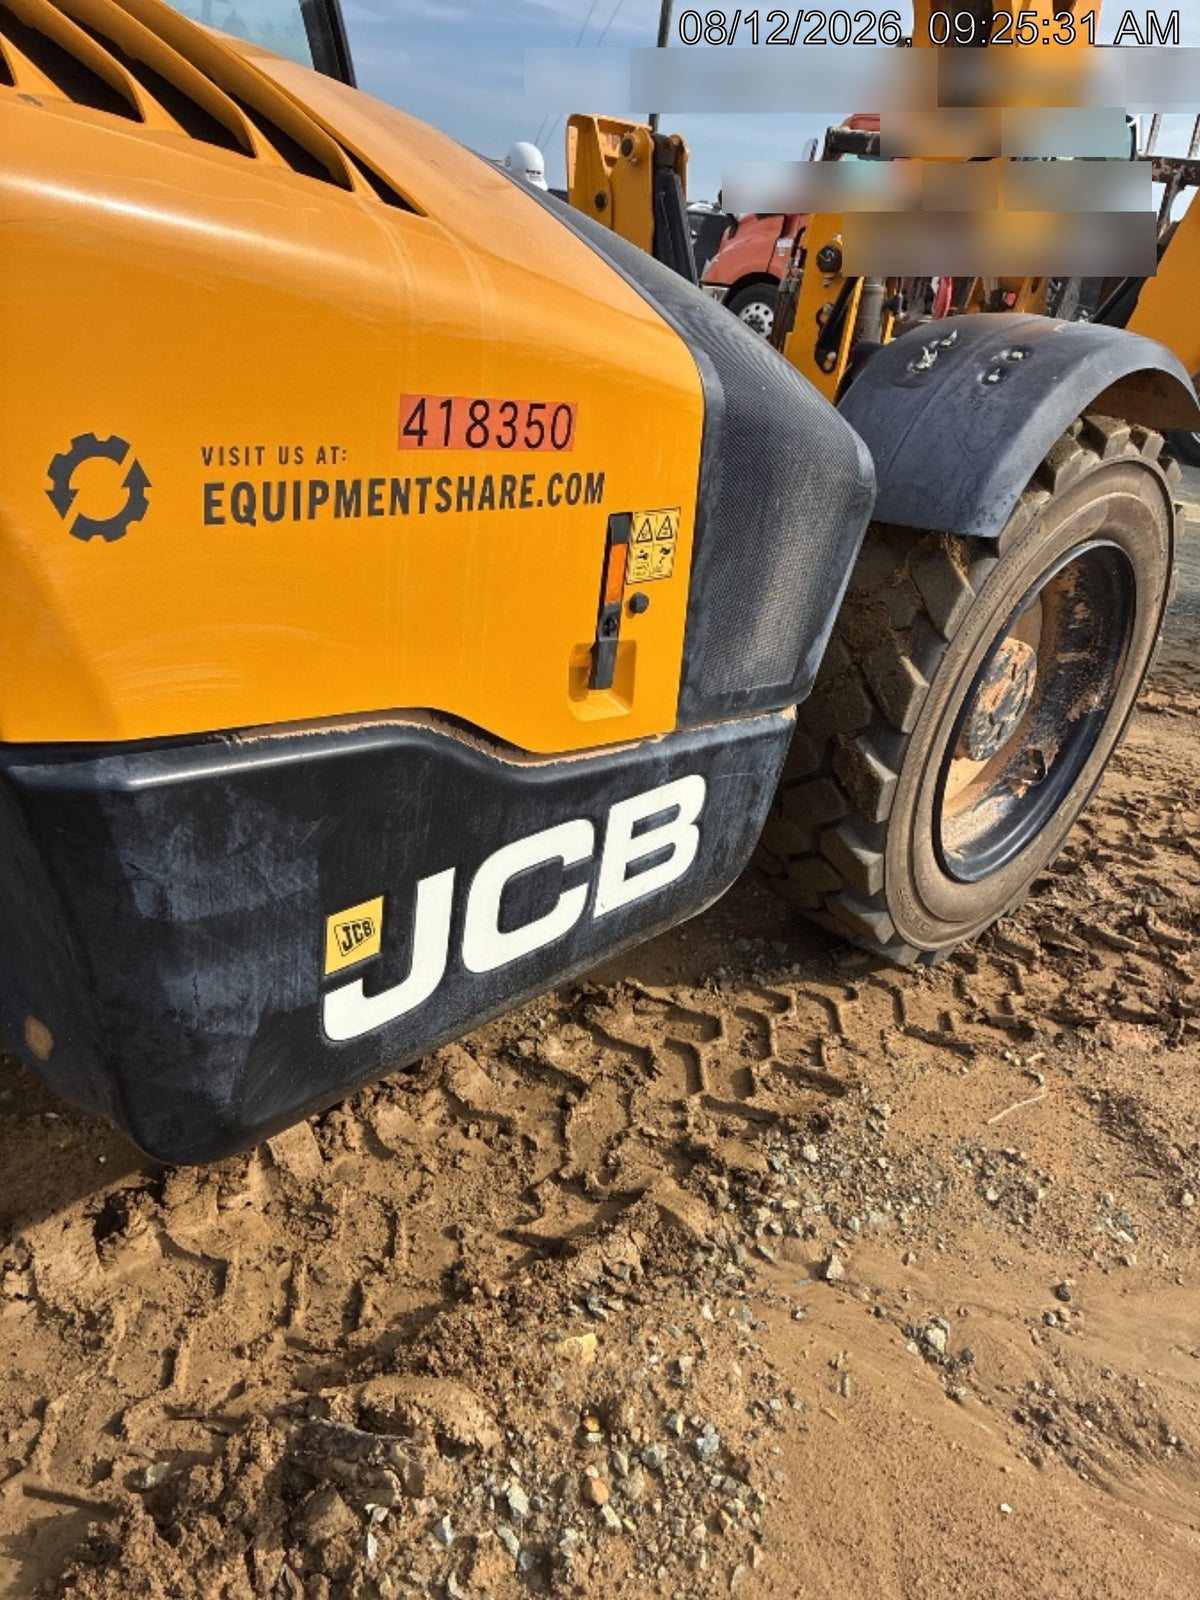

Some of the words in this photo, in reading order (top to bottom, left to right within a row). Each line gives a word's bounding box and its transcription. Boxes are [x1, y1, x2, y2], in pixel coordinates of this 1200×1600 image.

[402, 397, 573, 450] 418350
[201, 446, 265, 466] VISIT
[278, 446, 304, 465] US
[316, 446, 347, 465] AT:
[203, 472, 606, 527] EQUIPMENTSHARE.COM
[322, 774, 707, 1041] JCB
[341, 920, 373, 952] JCB
